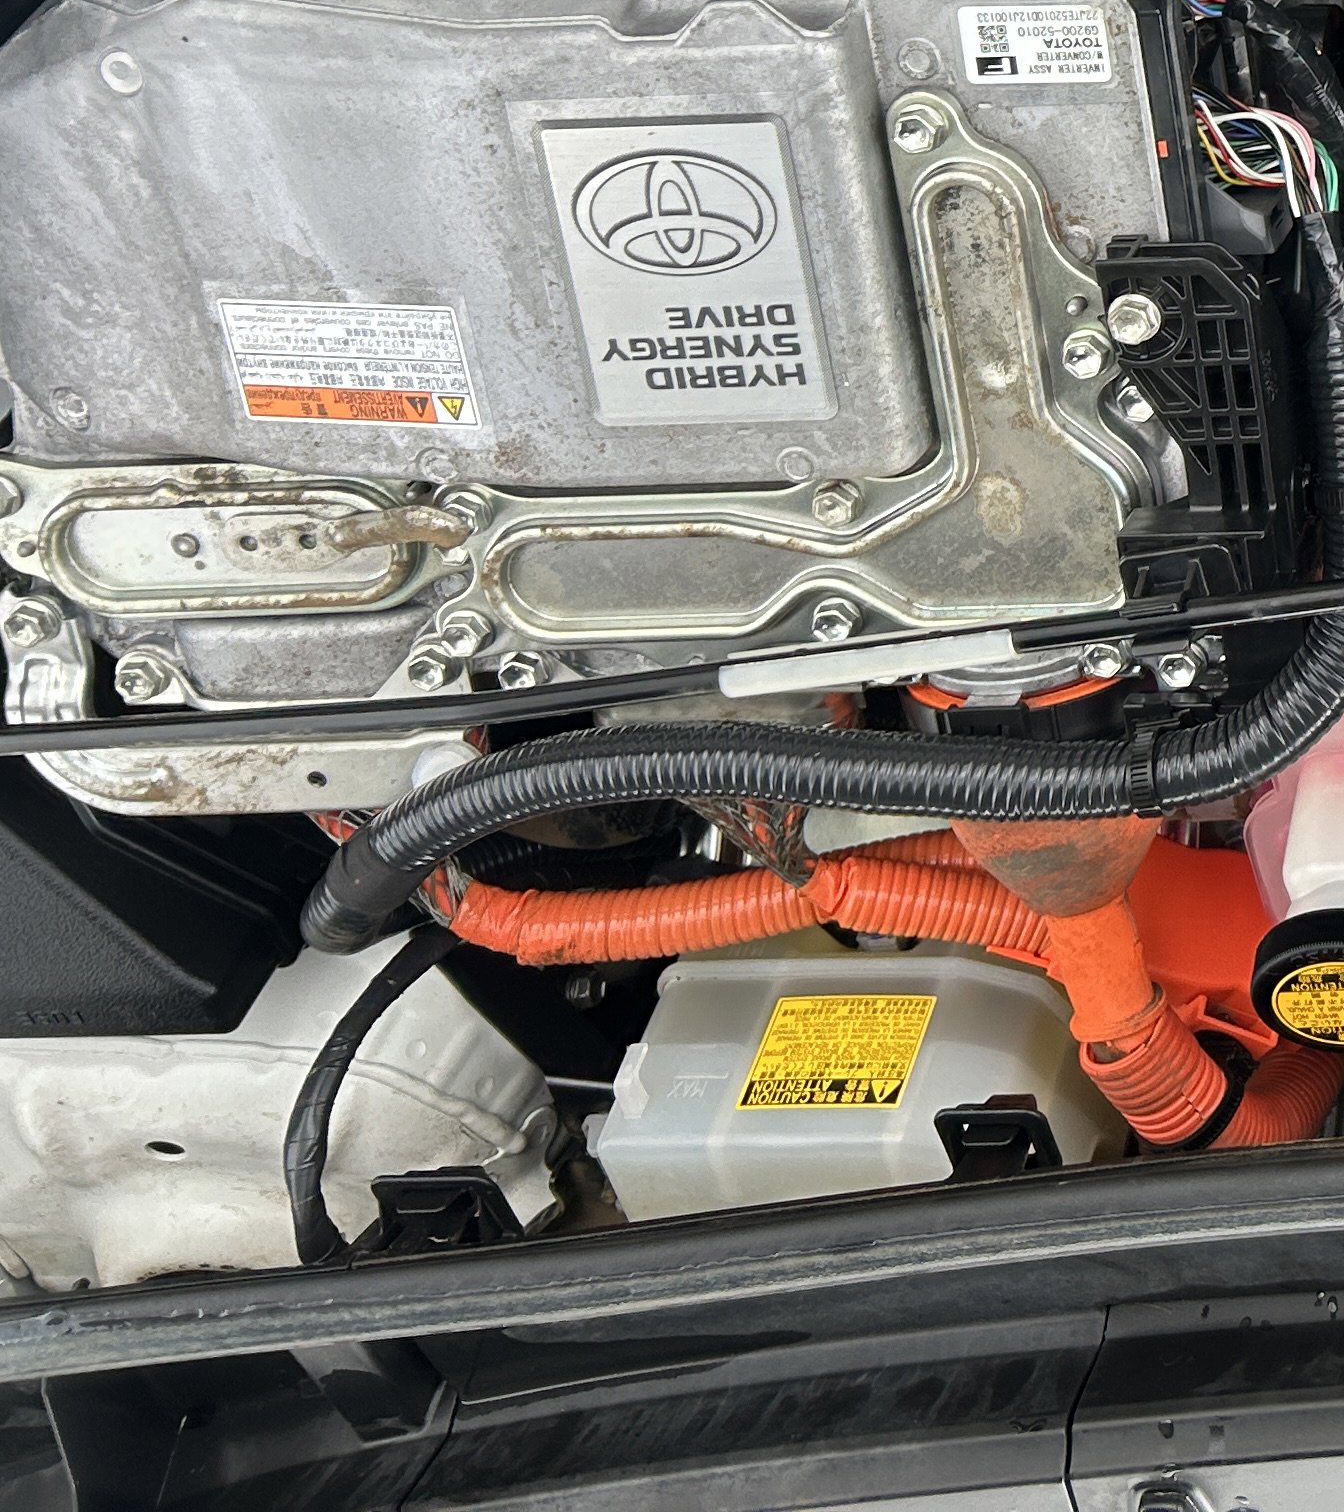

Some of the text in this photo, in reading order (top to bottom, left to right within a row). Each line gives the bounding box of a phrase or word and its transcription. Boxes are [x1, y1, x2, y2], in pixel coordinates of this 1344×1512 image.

[1018, 25, 1098, 37] G9200-52010
[1043, 38, 1102, 48] TOYOTA
[1036, 51, 1103, 61] W/CONVERTER
[1028, 63, 1105, 74] INVERTER ASSY
[665, 304, 796, 329] DRIVE
[602, 333, 802, 362] SYNERGY
[646, 364, 806, 390] HYBRID
[333, 390, 403, 404] AVERTISSEMENT
[350, 405, 408, 419] WARNING
[666, 1080, 708, 1098] MAX
[752, 1079, 831, 1091] ATTENTION
[747, 1091, 810, 1104] CAUTION
